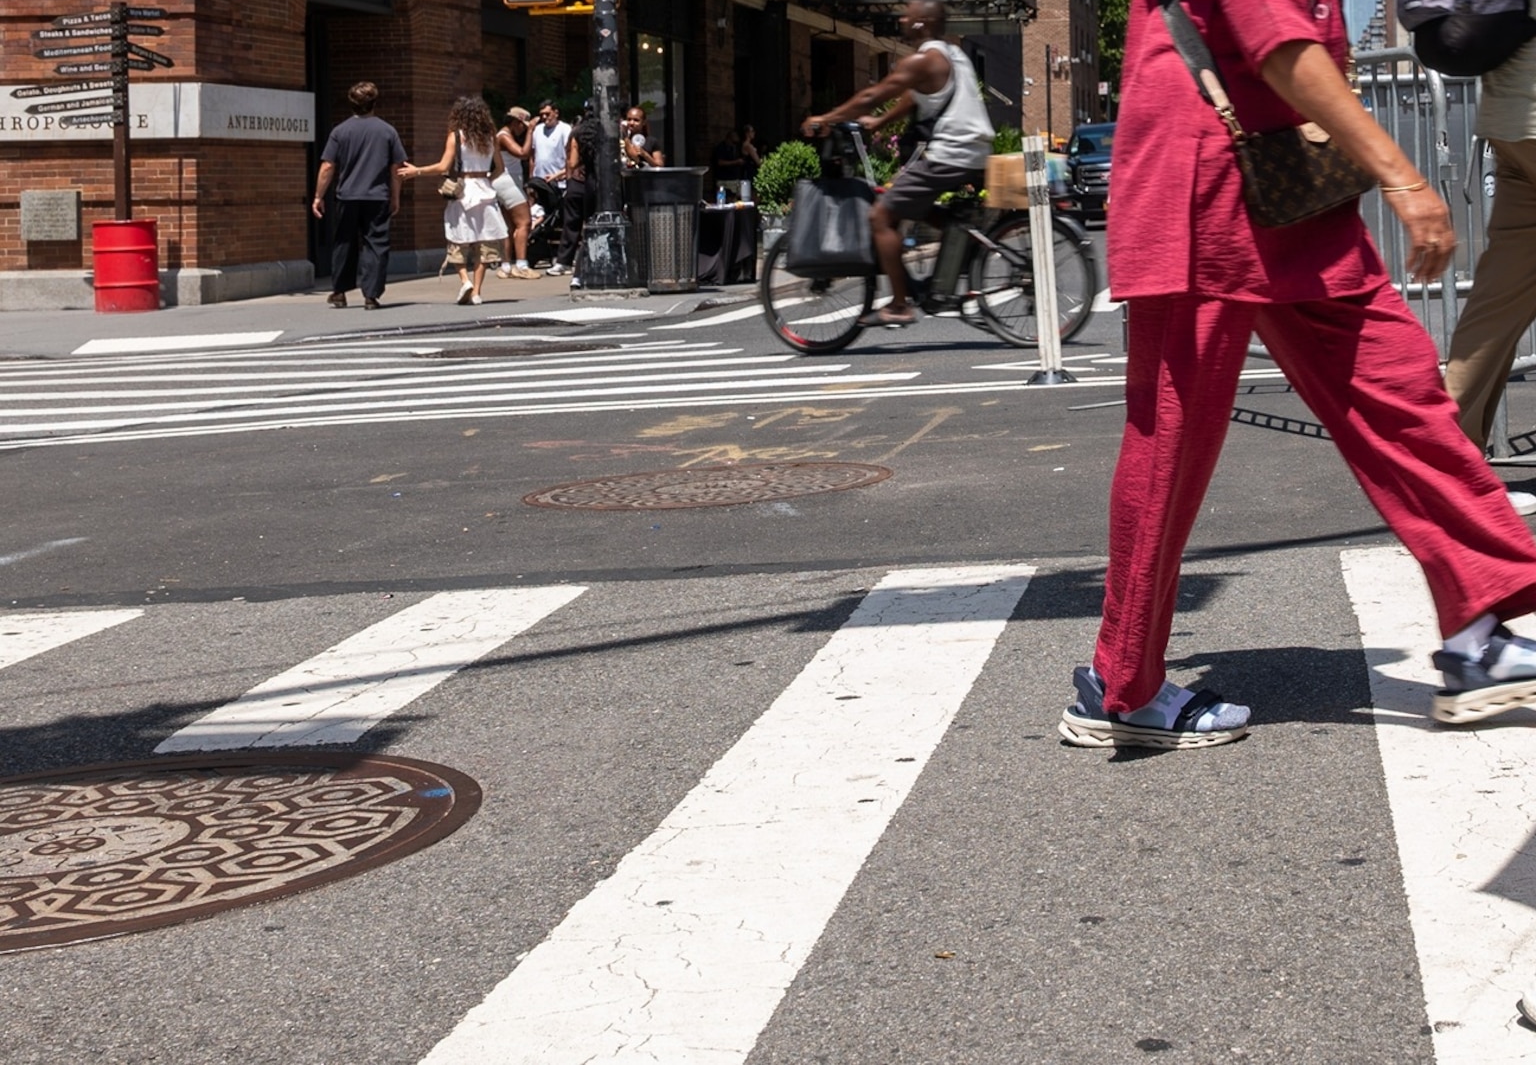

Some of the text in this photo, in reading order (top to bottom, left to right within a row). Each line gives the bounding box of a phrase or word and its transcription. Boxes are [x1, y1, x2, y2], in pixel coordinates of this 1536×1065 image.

[62, 17, 83, 25] Pizza
[90, 13, 112, 21] Tacos
[40, 27, 113, 38] Steaks & Sandwiches
[94, 44, 112, 52] Food
[94, 63, 110, 71] Beer
[43, 84, 81, 95] Doughnuts
[89, 80, 114, 89] Sweets
[37, 103, 65, 113] German
[81, 97, 114, 108] Jamaican
[227, 114, 309, 133] ANTHROPOLOGIE
